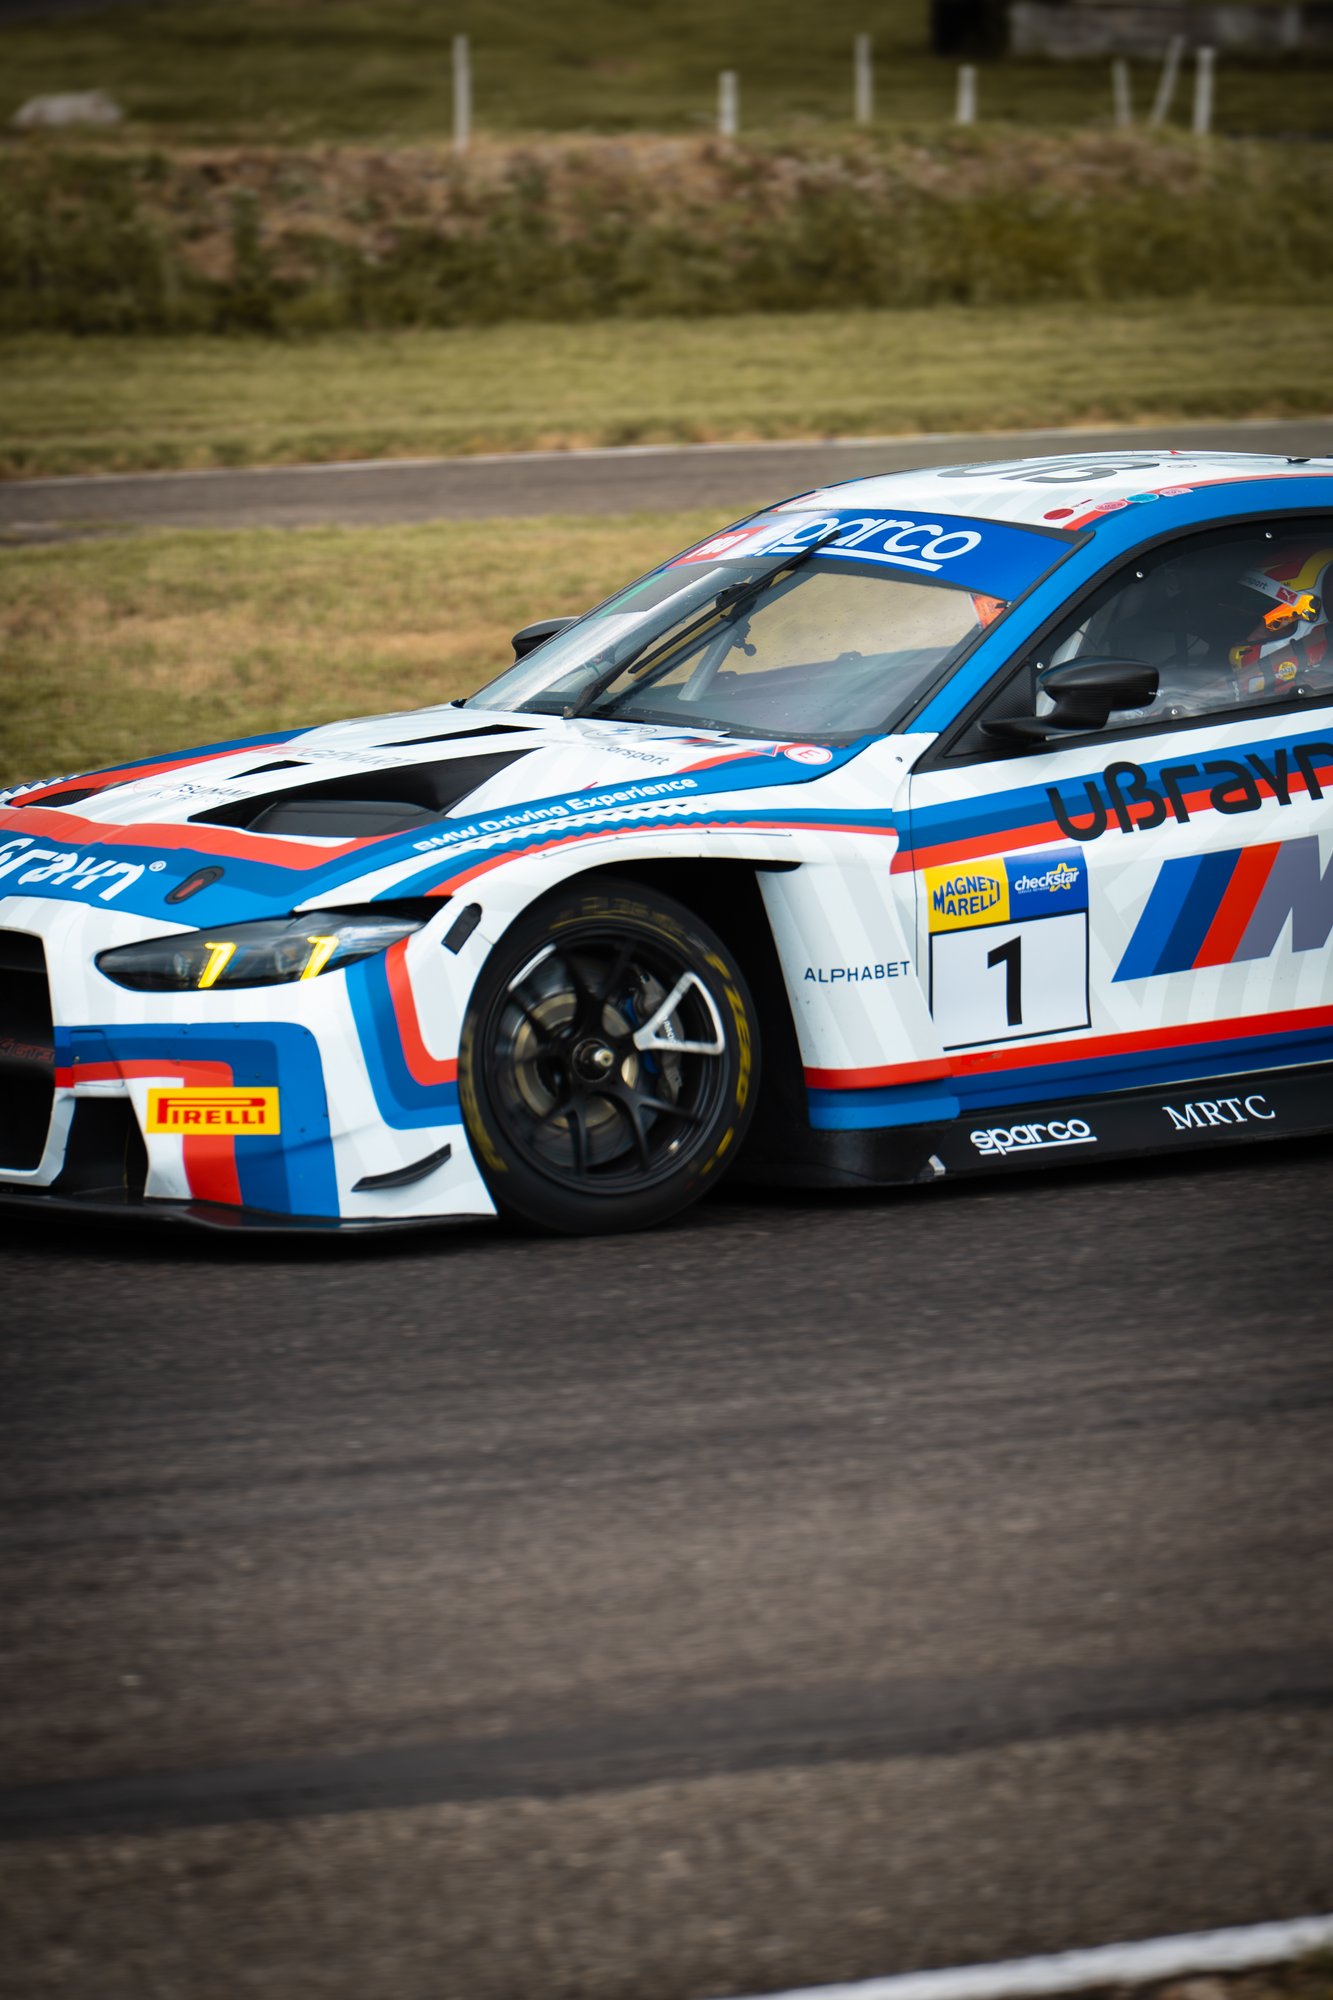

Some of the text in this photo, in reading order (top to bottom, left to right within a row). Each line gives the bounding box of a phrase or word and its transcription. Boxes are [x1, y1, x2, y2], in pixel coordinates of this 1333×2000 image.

[600, 743, 671, 766] orsport
[412, 777, 699, 851] BMW Driving Experience
[933, 876, 1000, 903] MAGNETI
[1014, 870, 1080, 892] checkstar
[804, 960, 911, 983] ALPHABET
[987, 935, 1023, 1026] 1
[157, 1097, 266, 1125] PIRELLI
[1162, 1094, 1276, 1130] MRTC
[970, 1119, 1092, 1155] sparco
